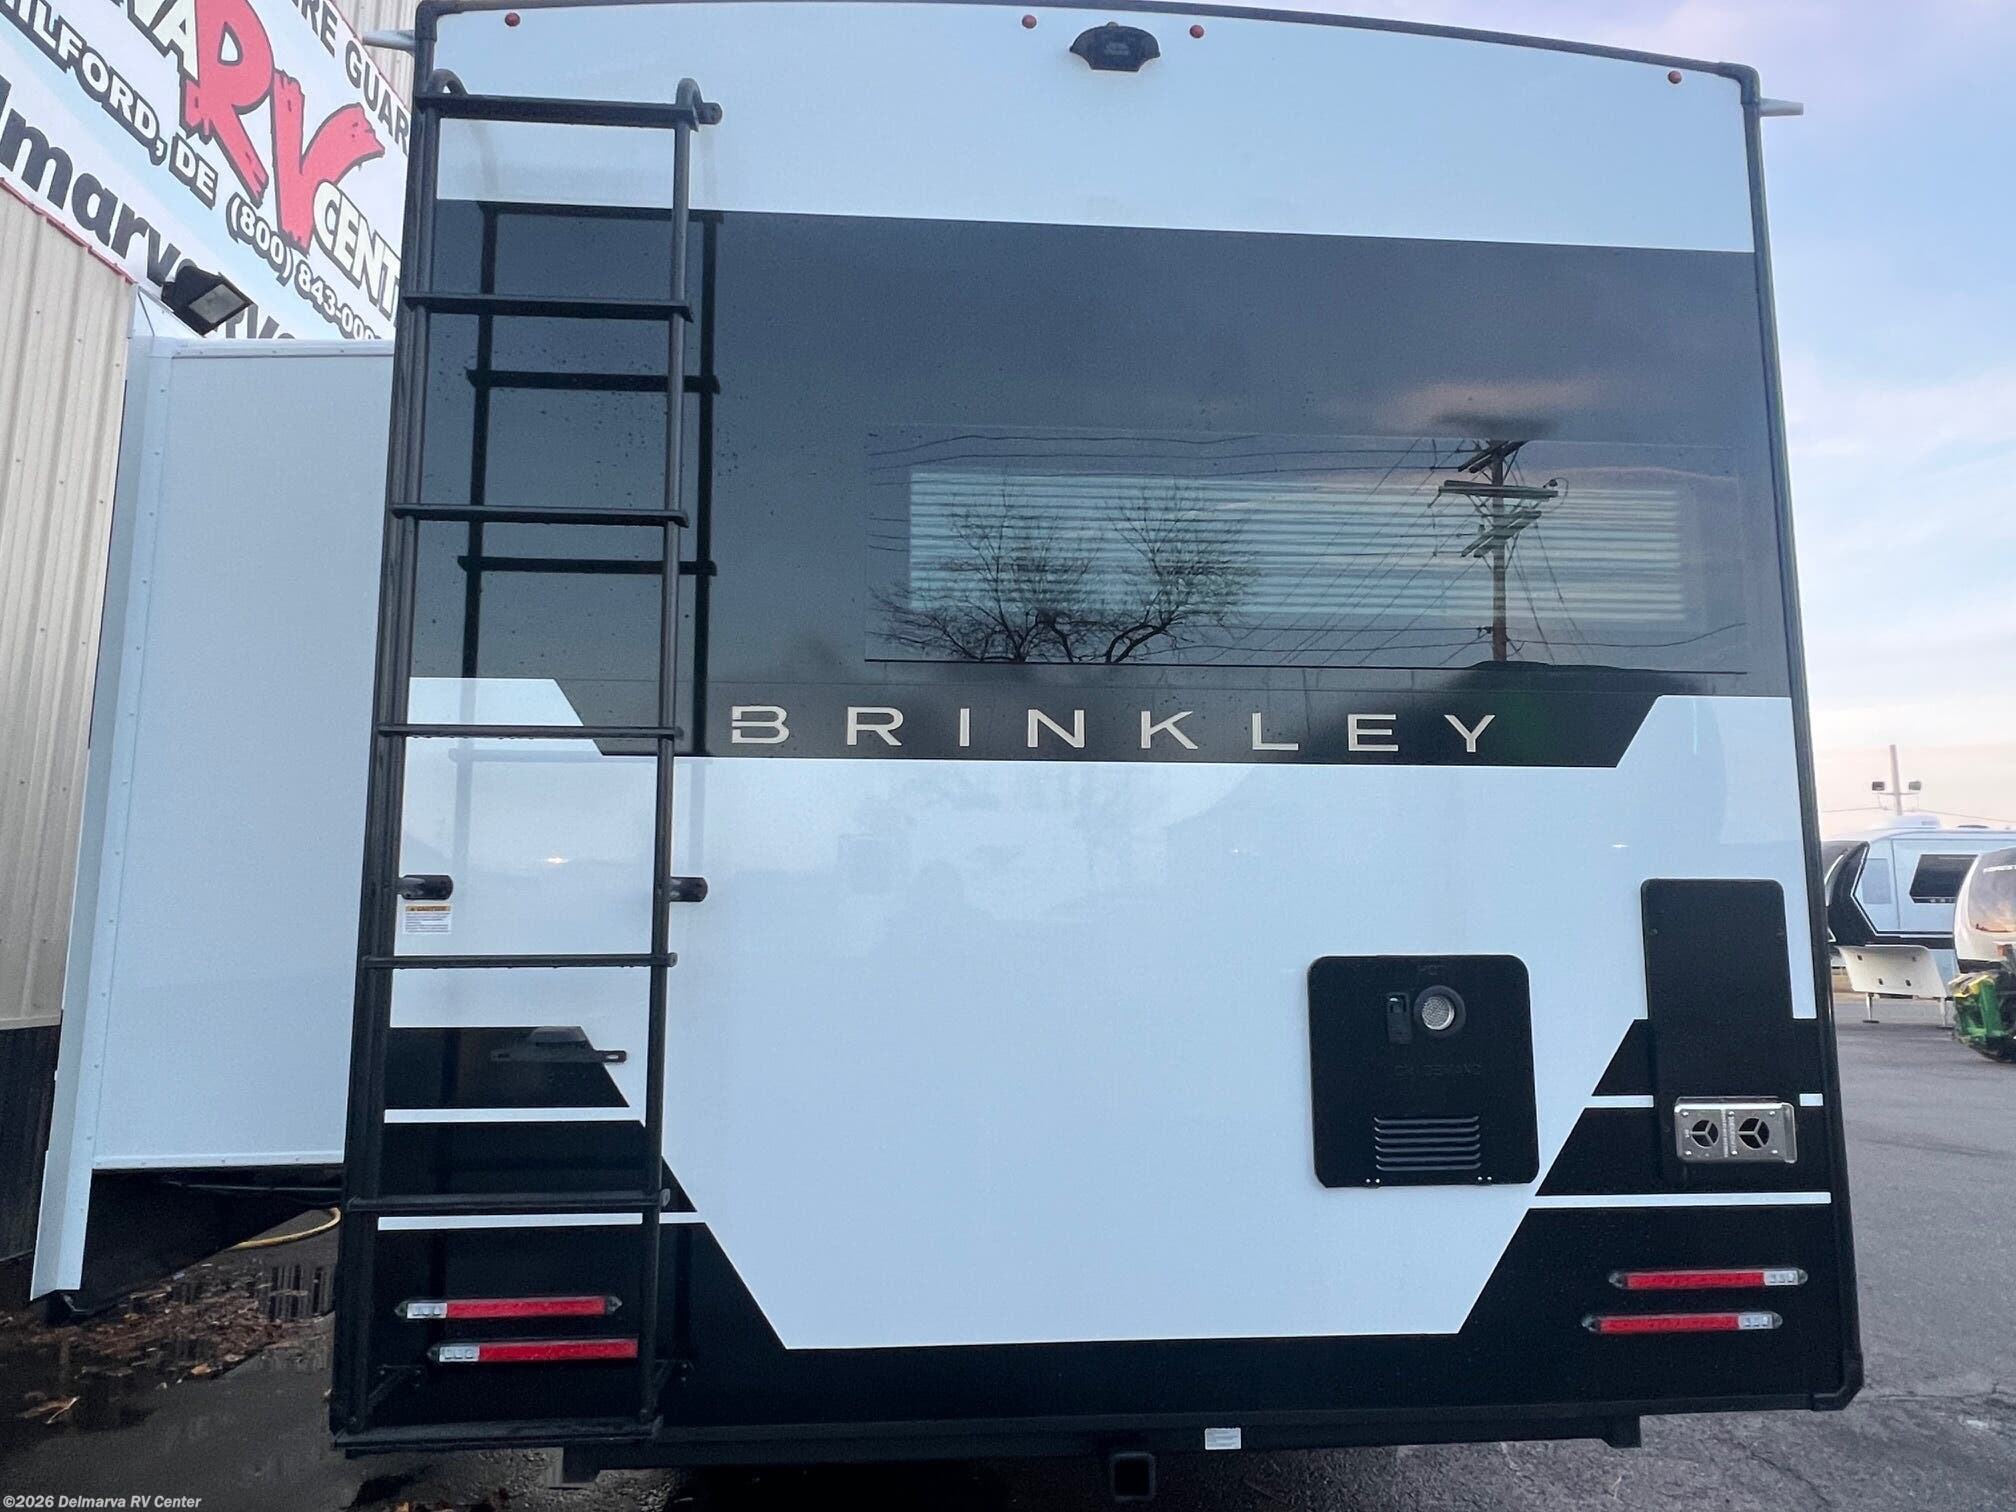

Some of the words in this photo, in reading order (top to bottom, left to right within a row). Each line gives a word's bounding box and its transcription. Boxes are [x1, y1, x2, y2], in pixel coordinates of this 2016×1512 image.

[0, 0, 167, 165] ILFORD,
[168, 132, 219, 210] DE
[226, 192, 295, 287] (800)
[294, 259, 382, 339] 843-00
[179, 0, 385, 258] RV
[731, 704, 1496, 753] BRINKLEY
